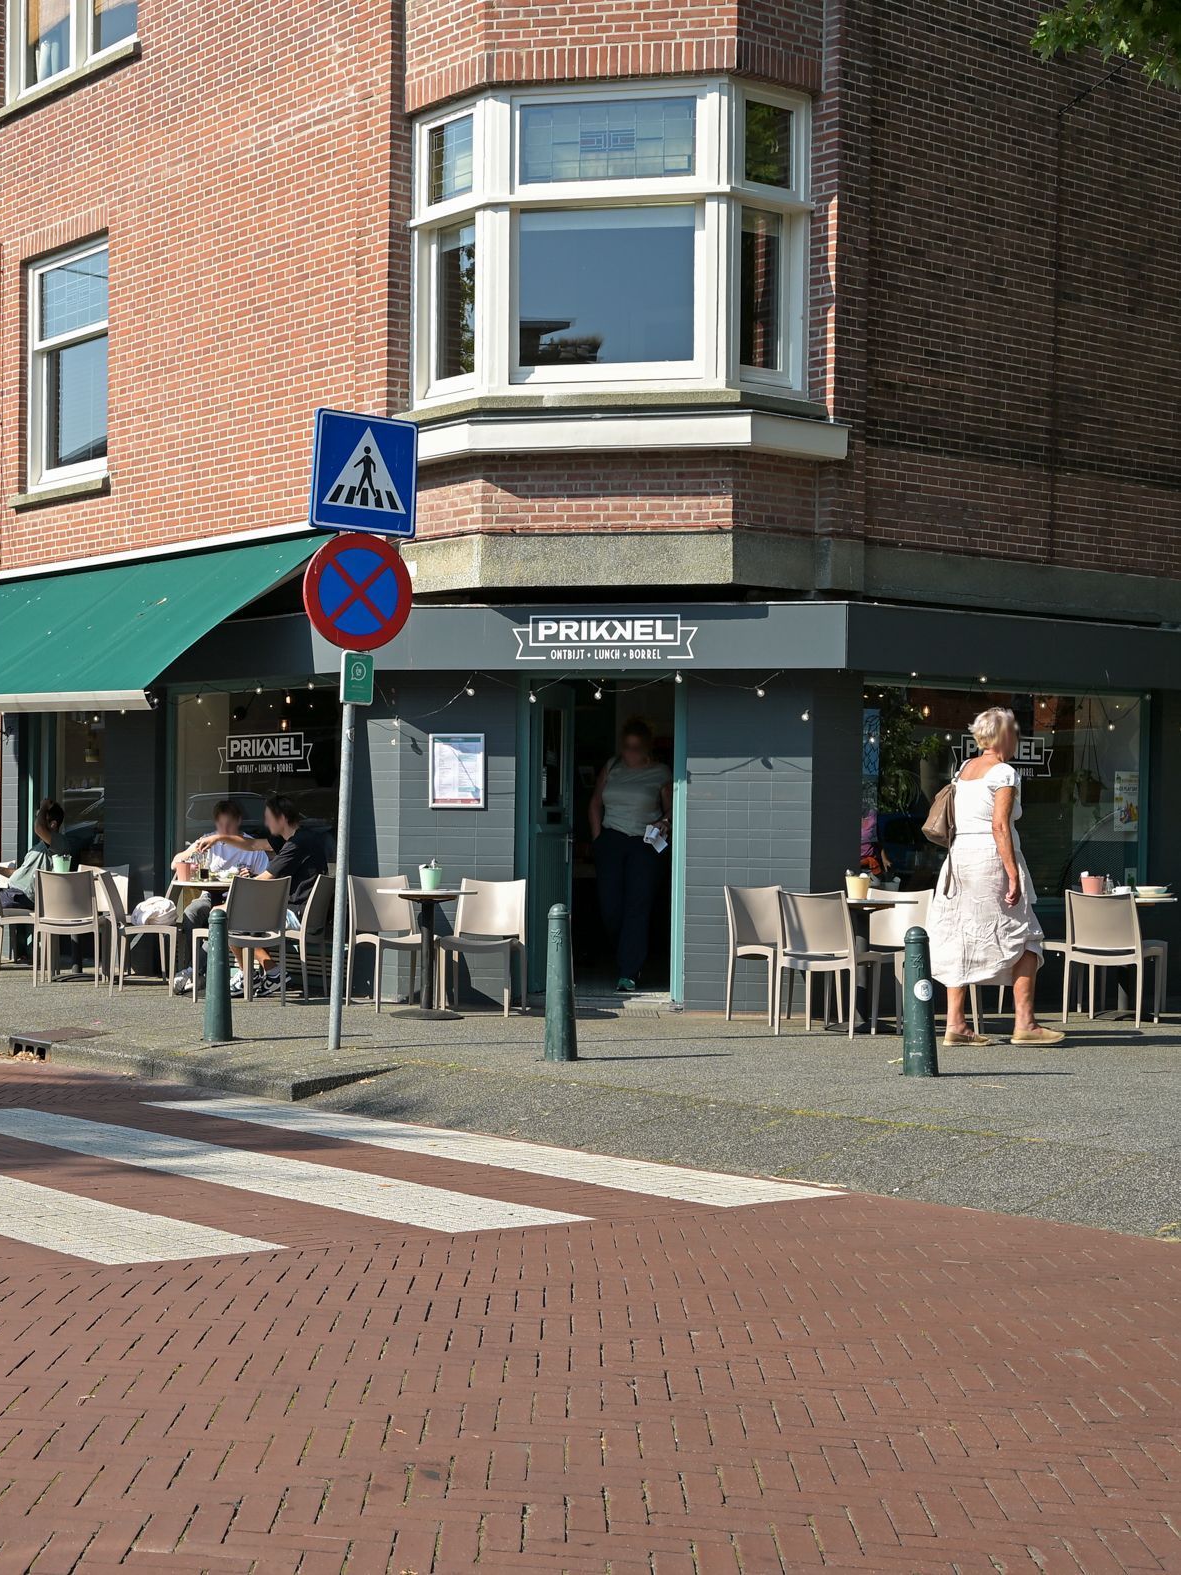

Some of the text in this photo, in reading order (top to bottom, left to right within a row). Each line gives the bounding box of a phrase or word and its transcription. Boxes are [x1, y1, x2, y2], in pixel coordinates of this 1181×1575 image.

[550, 649, 661, 660] ONTBIJT LUNCH BORREL
[236, 762, 294, 774] ONTBIJT LUNCH BORREL
